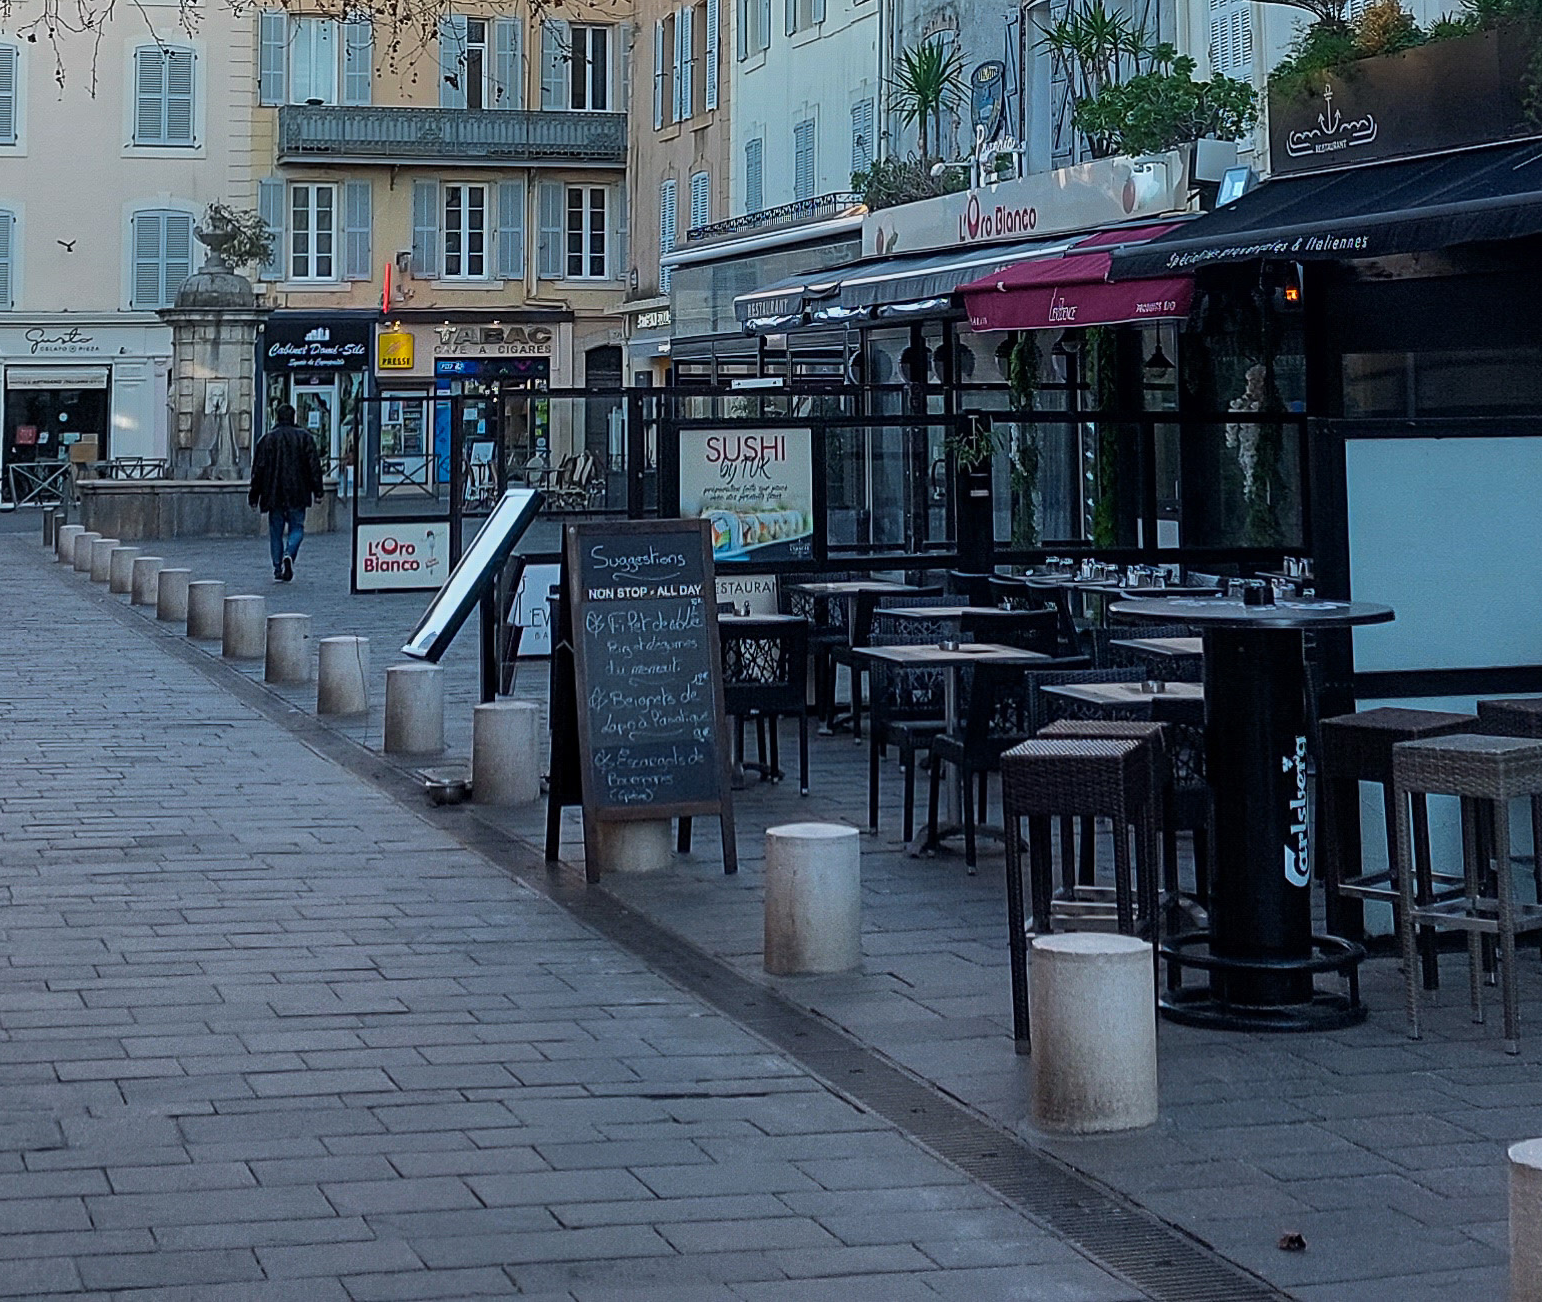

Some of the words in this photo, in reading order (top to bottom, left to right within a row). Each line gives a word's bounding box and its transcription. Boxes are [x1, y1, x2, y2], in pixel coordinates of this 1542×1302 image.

[995, 206, 1037, 235] Bianco
[25, 327, 93, 354] Gusto
[434, 326, 552, 345] TABAC
[434, 346, 467, 354] CAVE
[479, 346, 486, 354] A
[498, 345, 552, 354] CIGARES
[382, 357, 410, 365] PRESSE
[706, 436, 786, 463] SUSHI
[720, 457, 737, 485] by
[368, 538, 416, 556] L'Oro
[364, 557, 420, 573] Bianco
[591, 546, 686, 573] Suggestions
[588, 589, 614, 599] NON
[617, 586, 648, 598] STOP
[657, 586, 678, 596] ALL
[679, 584, 702, 596] DAY
